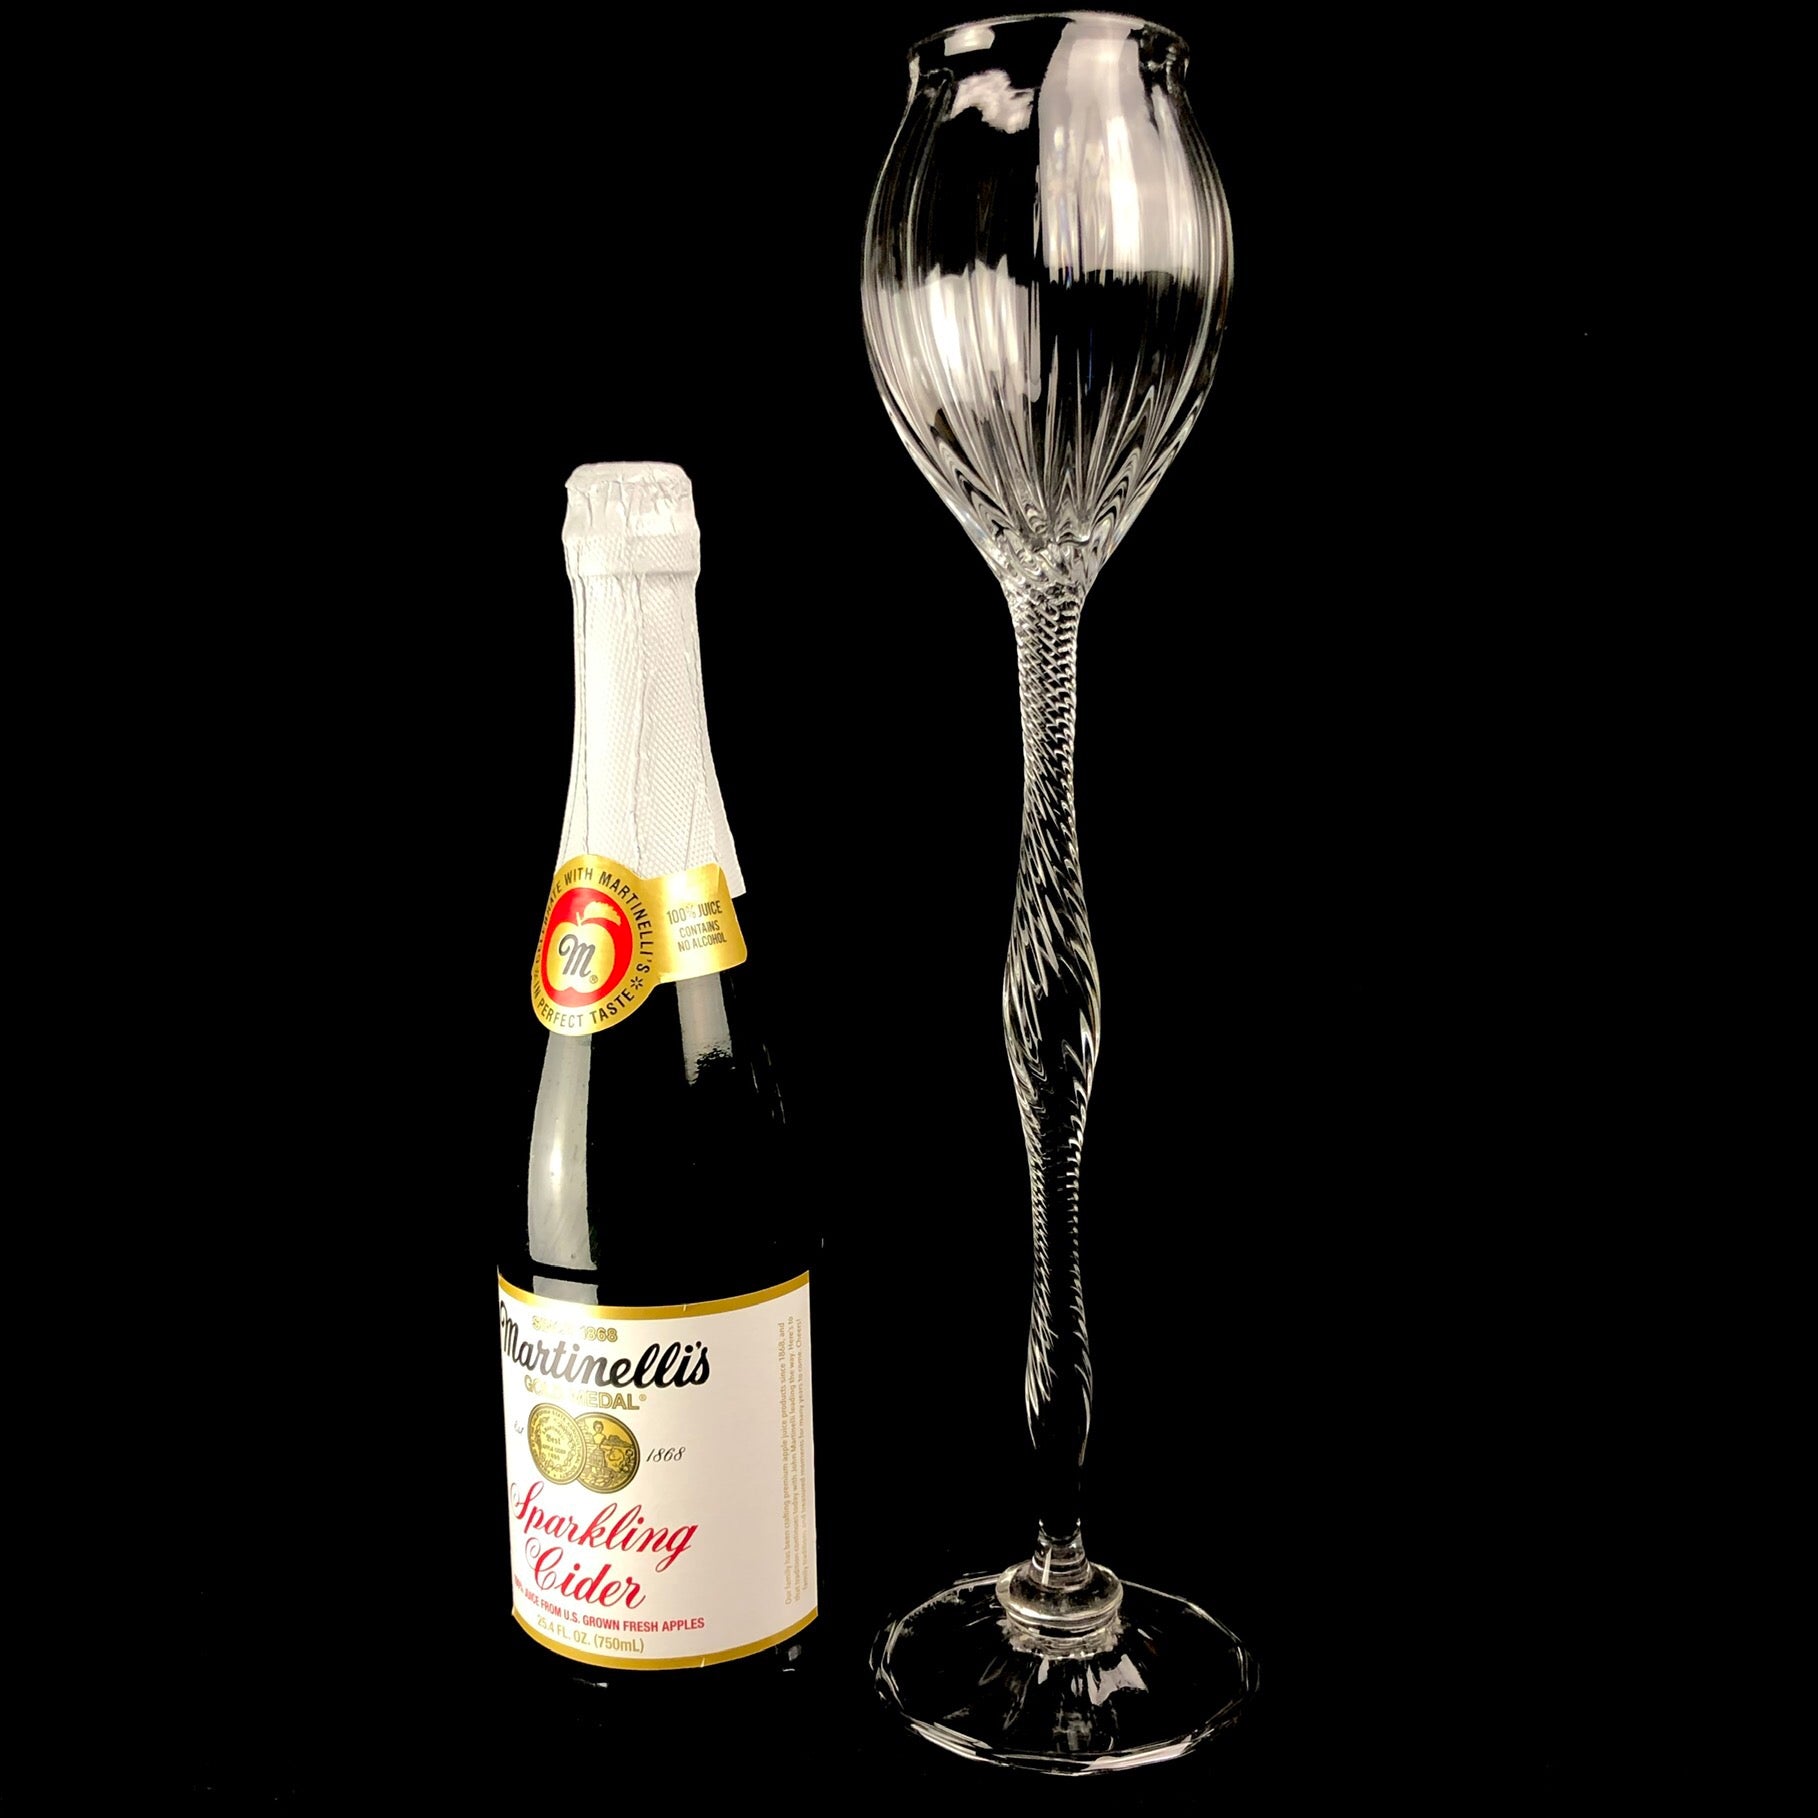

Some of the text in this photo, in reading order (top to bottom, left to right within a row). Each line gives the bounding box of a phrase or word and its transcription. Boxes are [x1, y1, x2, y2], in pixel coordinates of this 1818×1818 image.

[563, 867, 593, 885] WITH
[599, 871, 654, 973] MARTINELLI'S
[666, 900, 723, 925] 100% JUICE
[679, 919, 720, 938] CONTAINS
[677, 931, 727, 952] NO ALCOHOL
[537, 1000, 583, 1028] PERFECT
[590, 988, 635, 1025] TASTE
[500, 1300, 710, 1389] Martinelli's
[646, 1446, 686, 1462] 1868
[510, 1480, 699, 1573] Sparkling
[525, 1536, 646, 1610] Cider
[541, 1599, 562, 1617] FROM
[564, 1609, 580, 1624] U.S.
[582, 1615, 620, 1631] GROWN
[623, 1621, 659, 1632] FRESH
[661, 1617, 705, 1632] APPLES
[556, 1624, 571, 1640] FL.
[573, 1629, 591, 1646] OZ.
[594, 1633, 645, 1654] (750mL)
